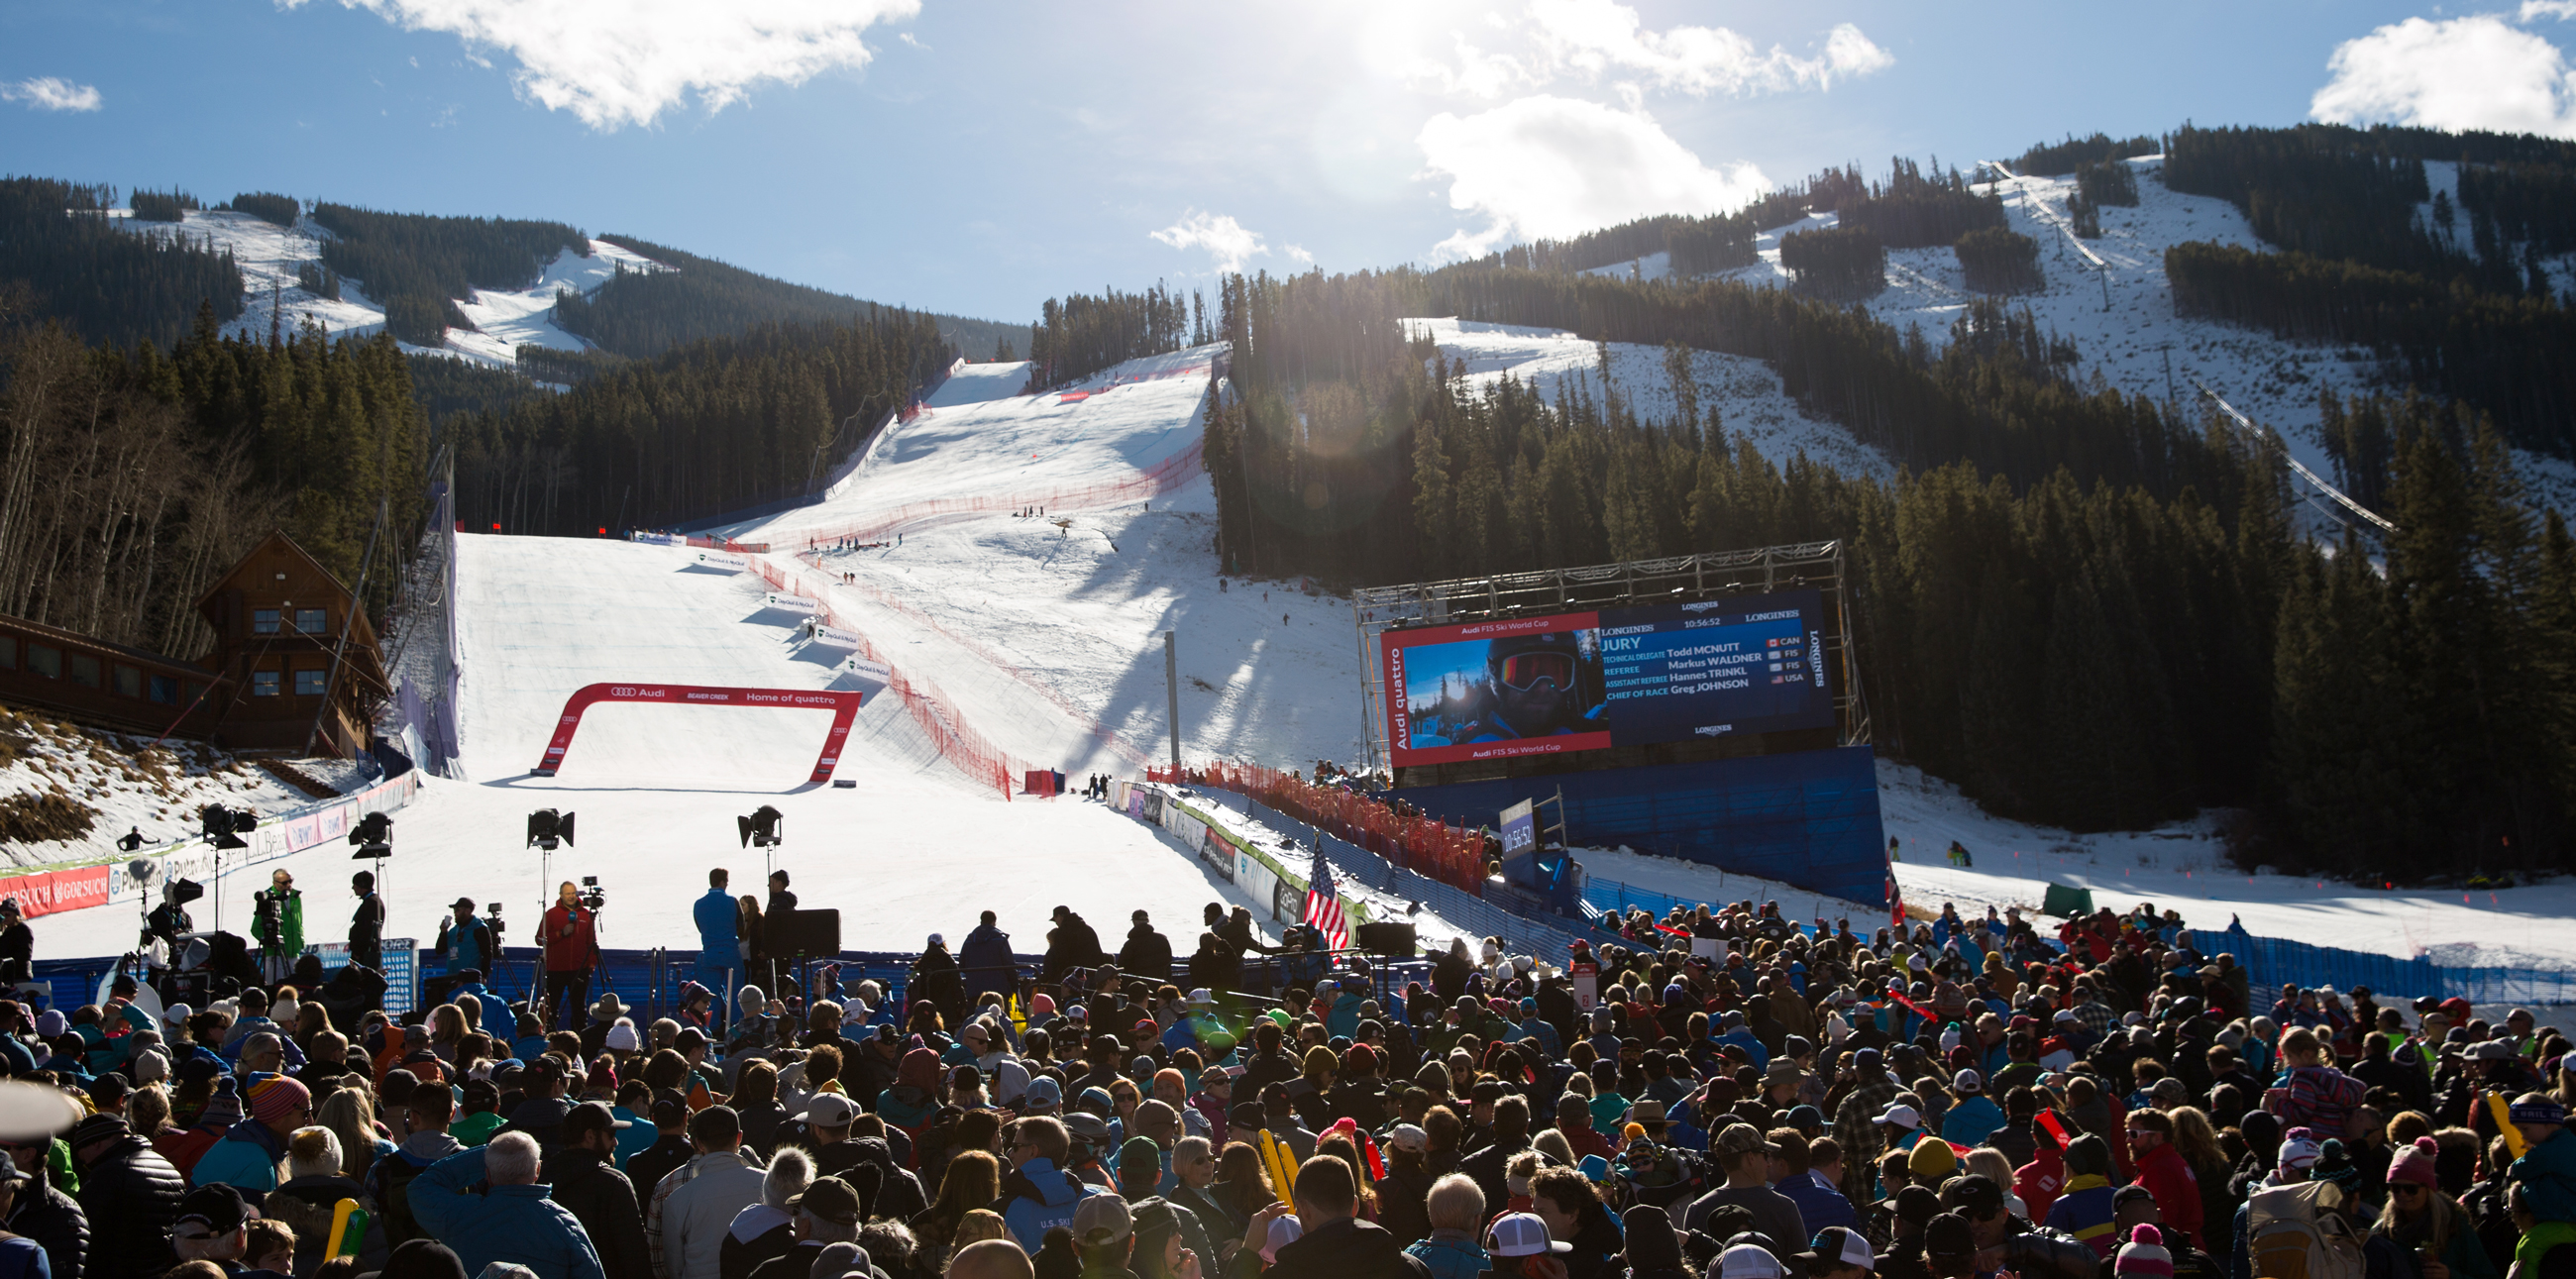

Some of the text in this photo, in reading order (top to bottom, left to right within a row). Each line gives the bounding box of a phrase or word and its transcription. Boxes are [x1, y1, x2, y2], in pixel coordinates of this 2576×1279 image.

[1681, 601, 1719, 611] LONGINES
[1684, 617, 1721, 628] 10:56:52
[1745, 609, 1799, 623] LONGINES
[1508, 621, 1533, 630] World
[1533, 620, 1549, 629] Cup
[1601, 624, 1655, 637] LONGINES
[825, 632, 841, 641] DayQuil
[844, 635, 857, 644] NyQuil
[1601, 637, 1642, 652] JURY
[1780, 637, 1800, 646] CAN
[1667, 642, 1740, 658] Todd MCNUTT
[1784, 649, 1798, 658] FIS
[1603, 651, 1665, 664] TECHNICAL DELEGATE
[1668, 652, 1763, 670] Markus WALDNER
[1809, 629, 1825, 688] LONGINES
[856, 663, 872, 672] DayQuil
[876, 667, 889, 676] NyQuil
[1604, 666, 1640, 676] REFEREE
[1786, 661, 1800, 671] FIS
[1669, 666, 1747, 683] Hannes TRINKL
[1784, 674, 1803, 683] USA
[1605, 675, 1668, 689] ASSISTANT REFEREE
[1670, 678, 1749, 695] Greg JOHNSON
[639, 689, 665, 697] Audi
[746, 693, 779, 701] Home
[795, 695, 835, 704] quattro
[1392, 648, 1408, 750] Audi quattro
[1606, 691, 1631, 700] CHIEF
[1646, 688, 1668, 696] RACE
[1694, 724, 1732, 734] LONGINES
[1520, 744, 1545, 753] World
[1546, 743, 1560, 752] Cup
[1504, 824, 1532, 852] 10:56:52
[63, 876, 107, 900] GORSUCH
[1279, 888, 1298, 913] GoPro
[1040, 1218, 1070, 1228] U.S. SKI
